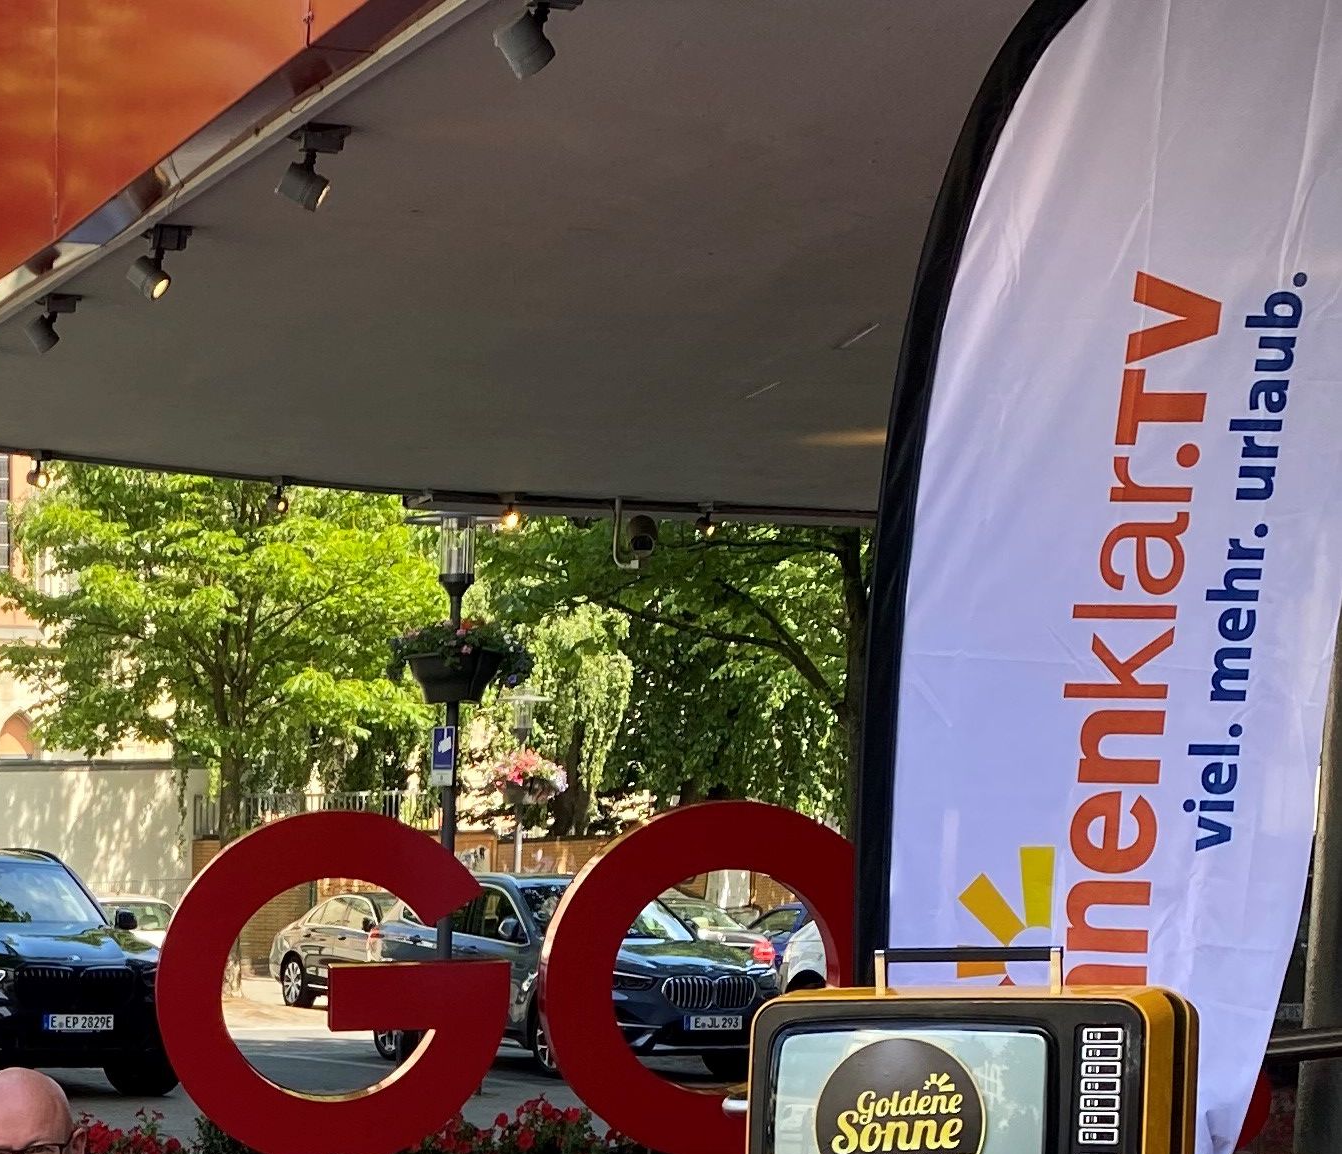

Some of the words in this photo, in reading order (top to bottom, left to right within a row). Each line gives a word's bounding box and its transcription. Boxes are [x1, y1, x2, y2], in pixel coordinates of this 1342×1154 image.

[1229, 271, 1308, 502] urlaub.
[1063, 270, 1222, 986] nenklar.TV
[1205, 522, 1269, 702] mehr.
[1183, 722, 1243, 852] viel.
[856, 1089, 963, 1126] Goldene
